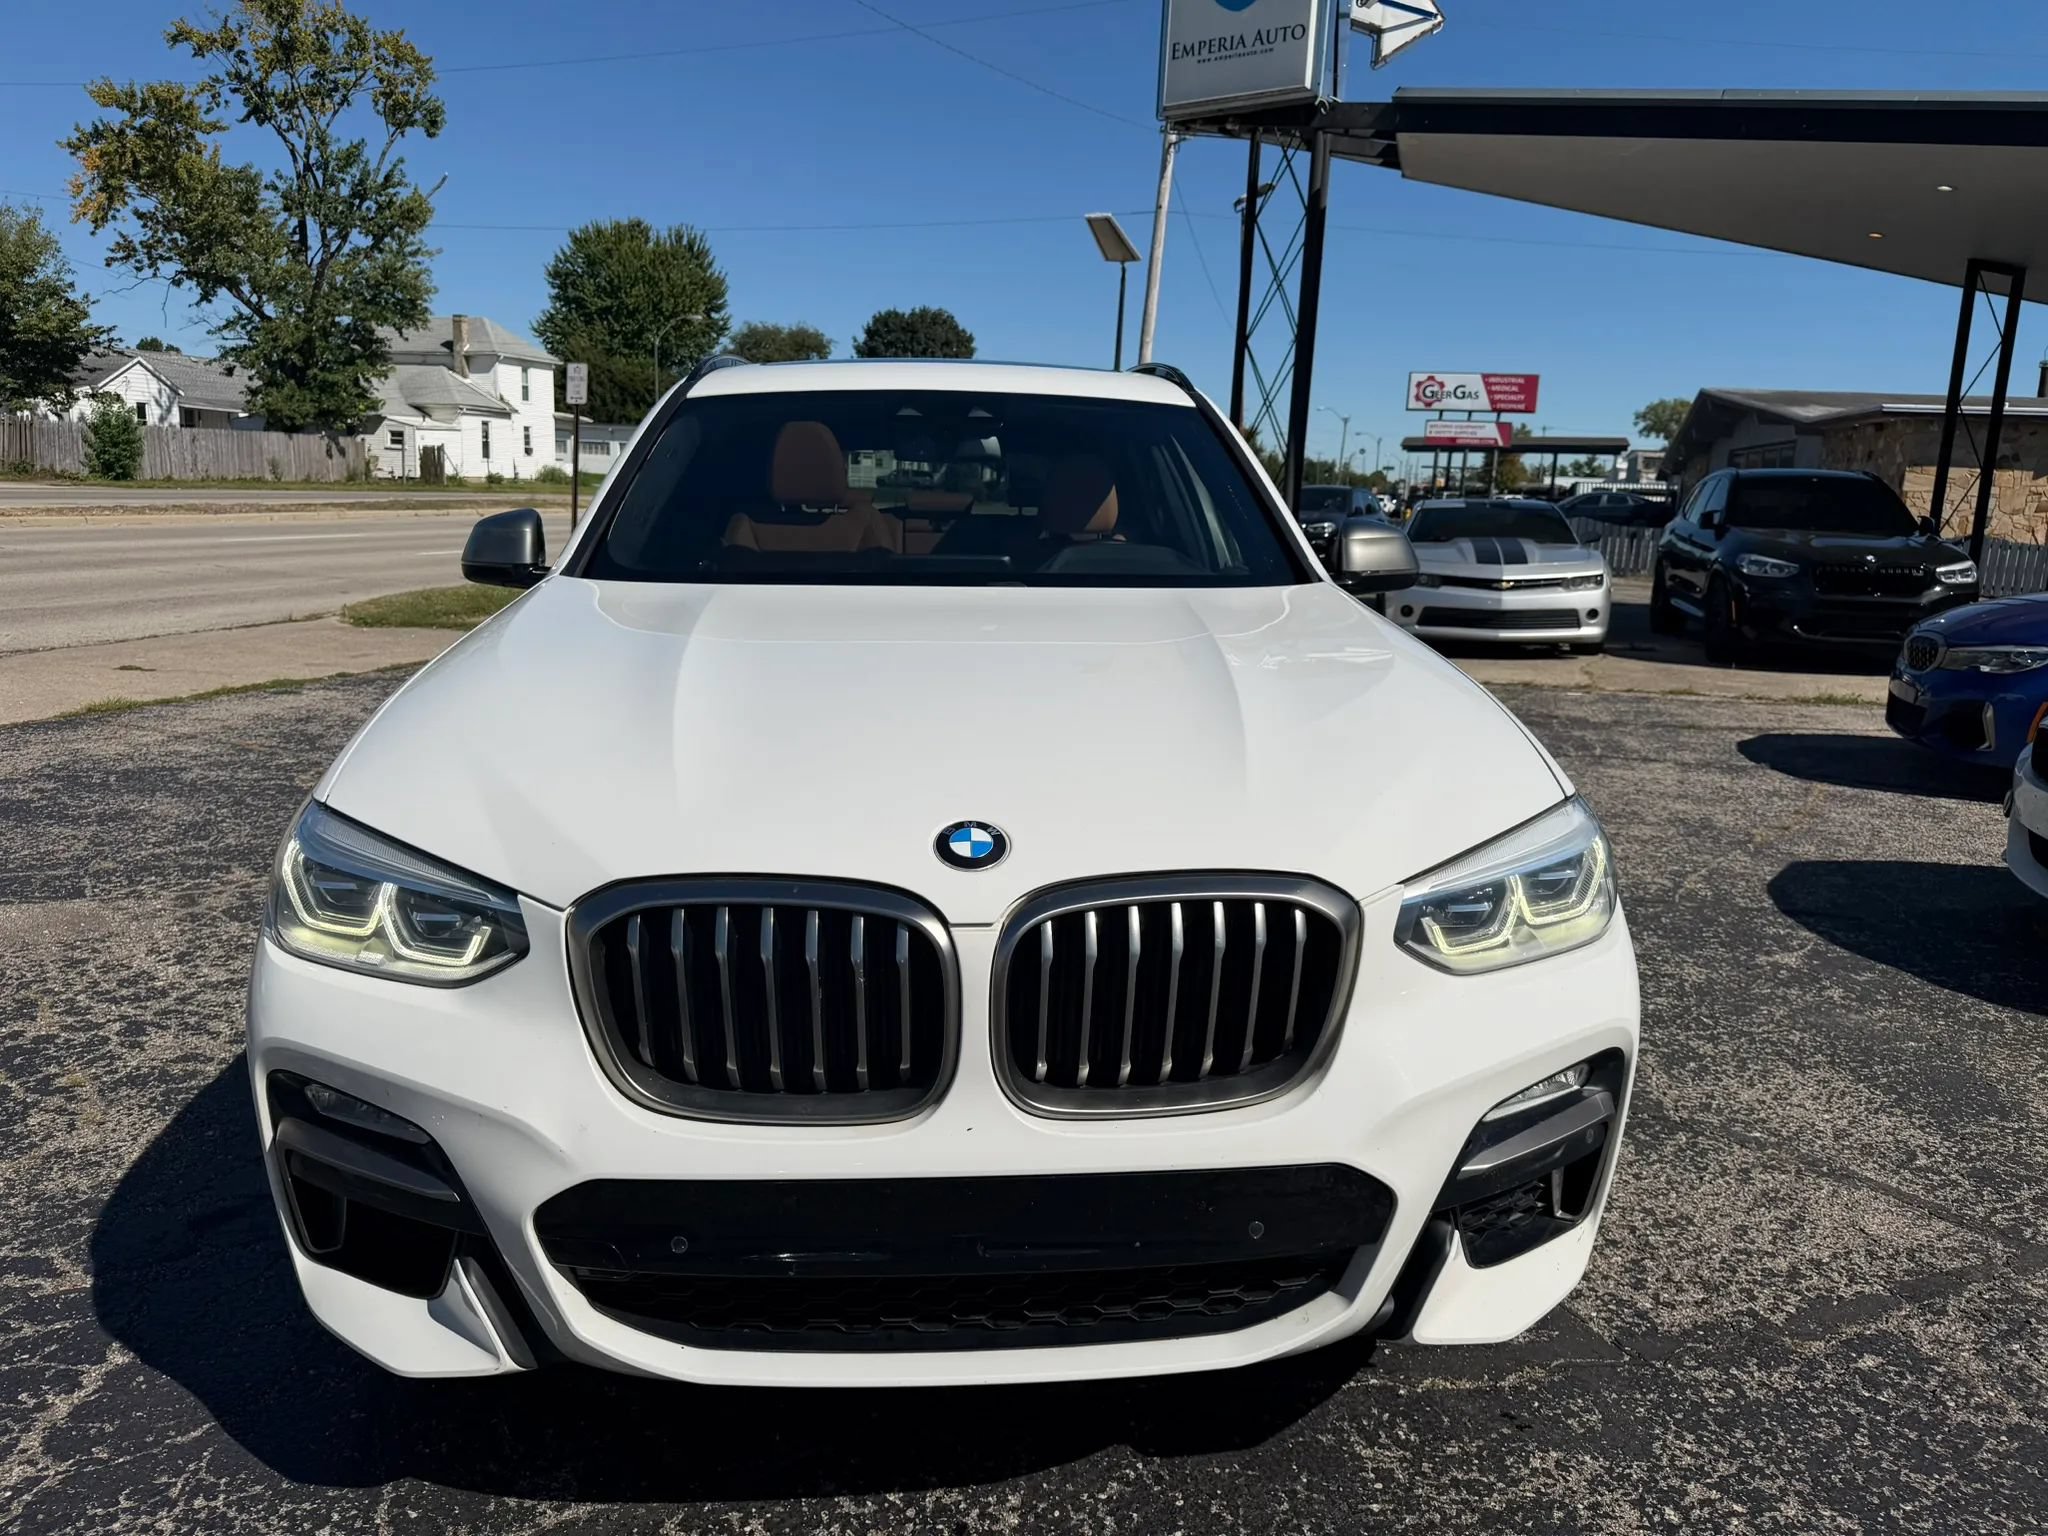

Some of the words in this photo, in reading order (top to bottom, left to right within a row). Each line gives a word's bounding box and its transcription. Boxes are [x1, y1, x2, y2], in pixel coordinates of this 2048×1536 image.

[1172, 33, 1247, 60] EMPERIA
[1252, 23, 1306, 47] AUTO
[943, 821, 1000, 836] BMW
